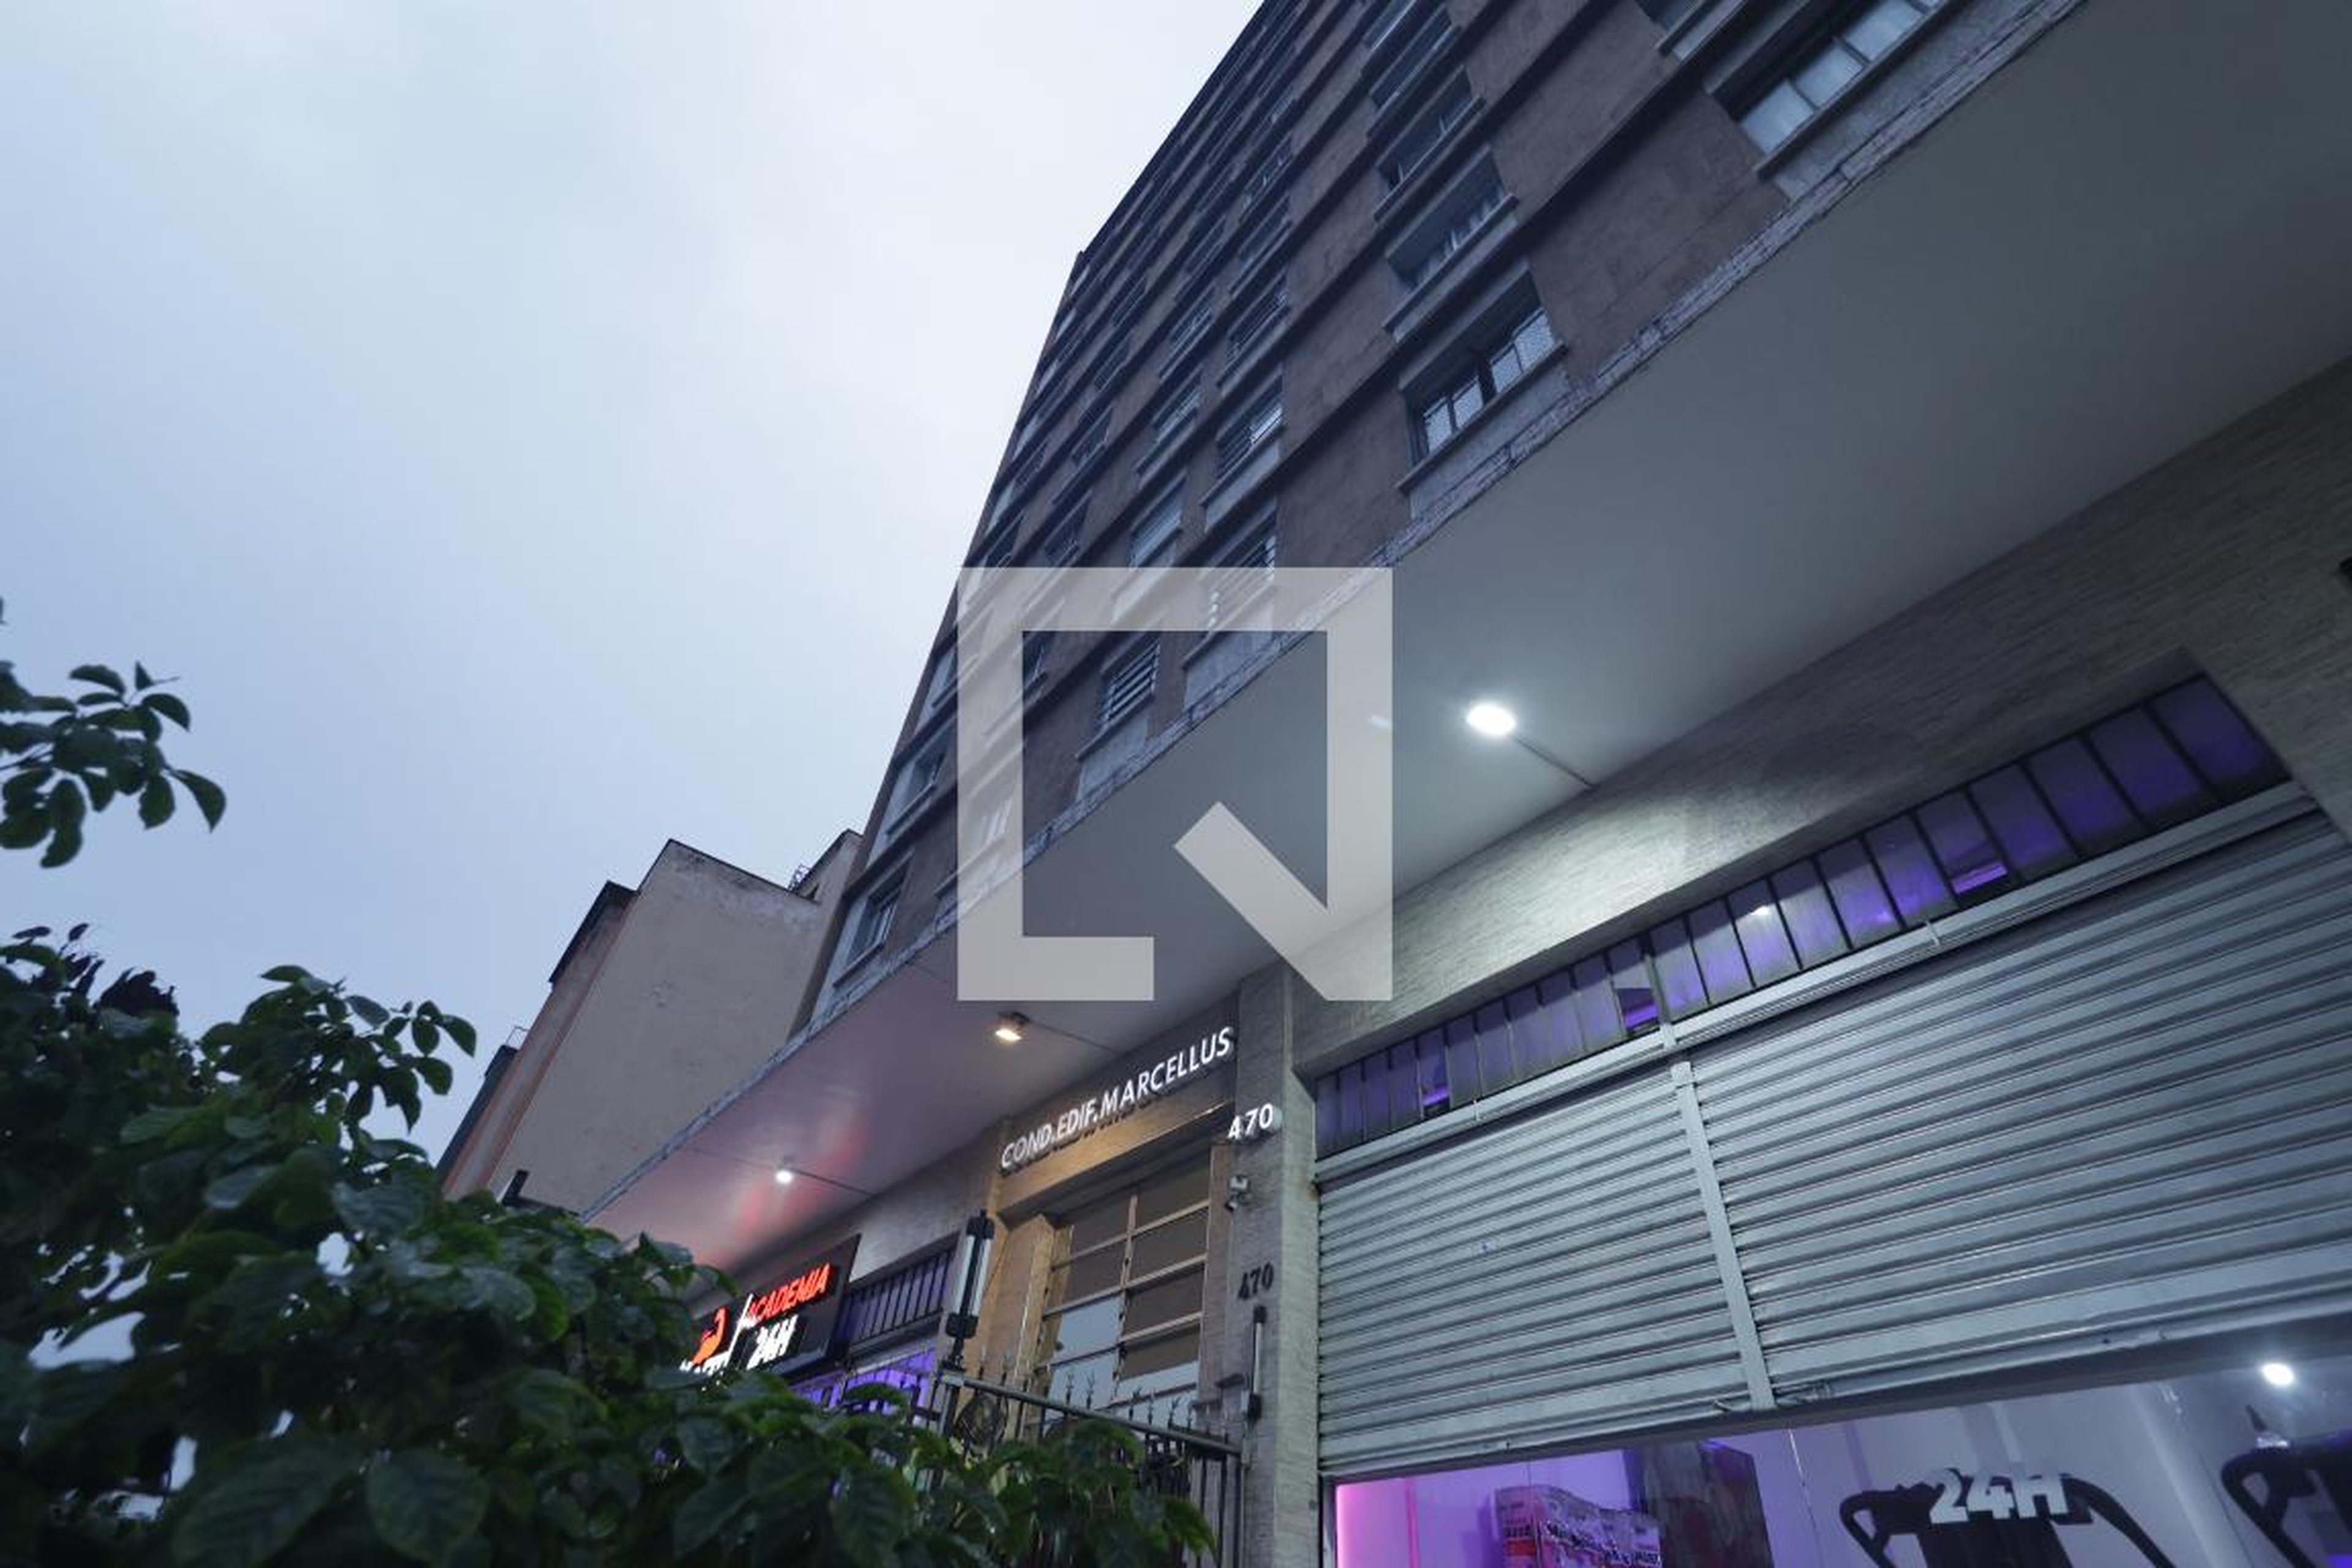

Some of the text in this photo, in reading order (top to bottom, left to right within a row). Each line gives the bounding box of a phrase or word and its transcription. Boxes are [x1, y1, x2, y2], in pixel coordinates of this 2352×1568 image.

[1227, 1102, 1274, 1140] 470
[743, 1262, 831, 1325] ACADEMIA
[1237, 1262, 1275, 1300] 470
[1929, 1459, 2069, 1525] 24H
